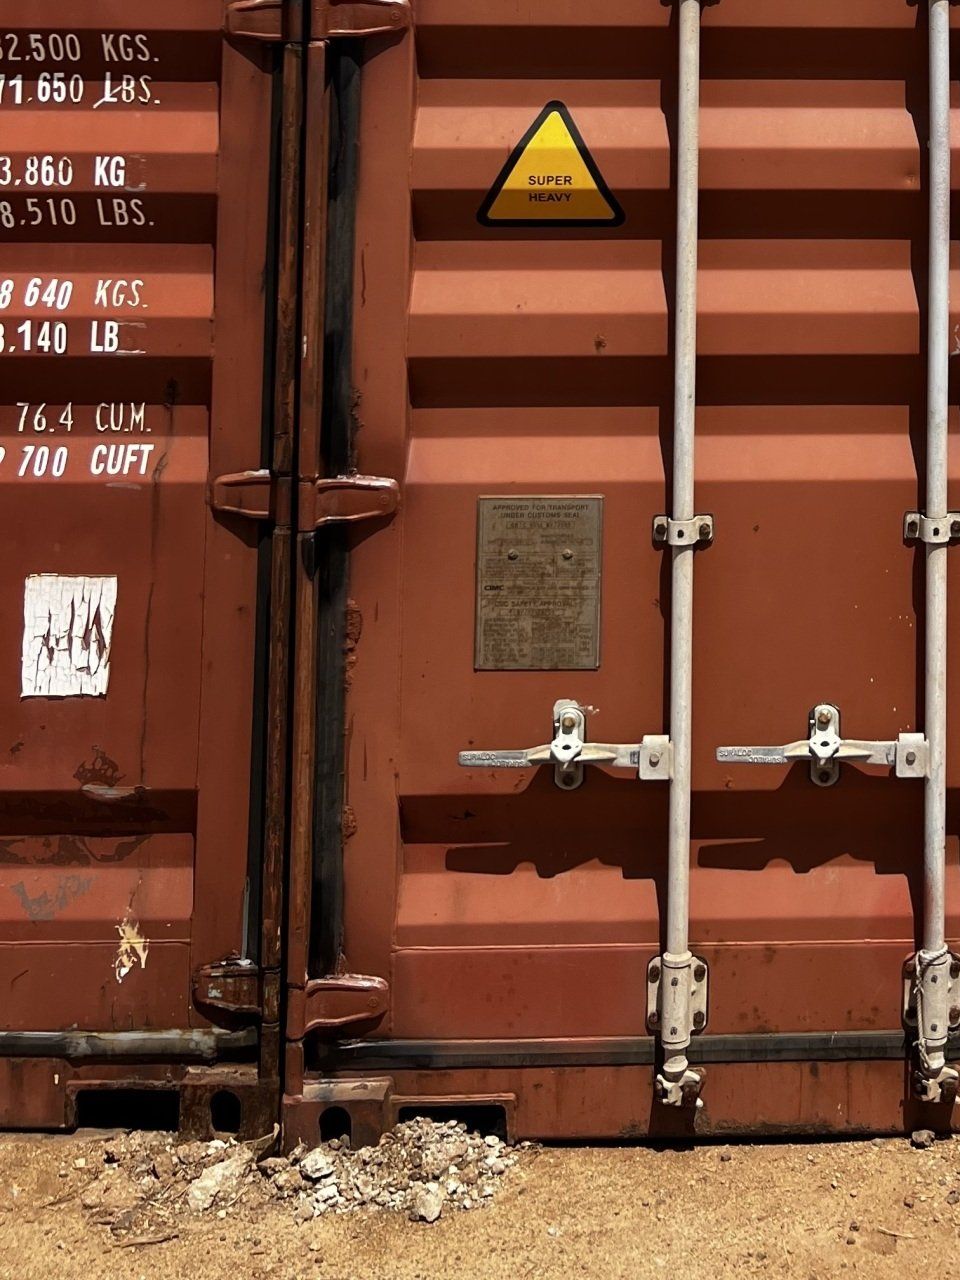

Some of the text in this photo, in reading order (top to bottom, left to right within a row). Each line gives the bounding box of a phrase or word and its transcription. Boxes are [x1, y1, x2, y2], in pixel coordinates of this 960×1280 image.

[0, 33, 160, 62] 2,500 KGS.
[528, 175, 573, 185] SUPER
[528, 192, 572, 202] HEAVY
[96, 198, 155, 226] LBS.
[94, 279, 149, 308] KGS.
[16, 402, 74, 432] 76.4
[91, 444, 155, 475] CUFT
